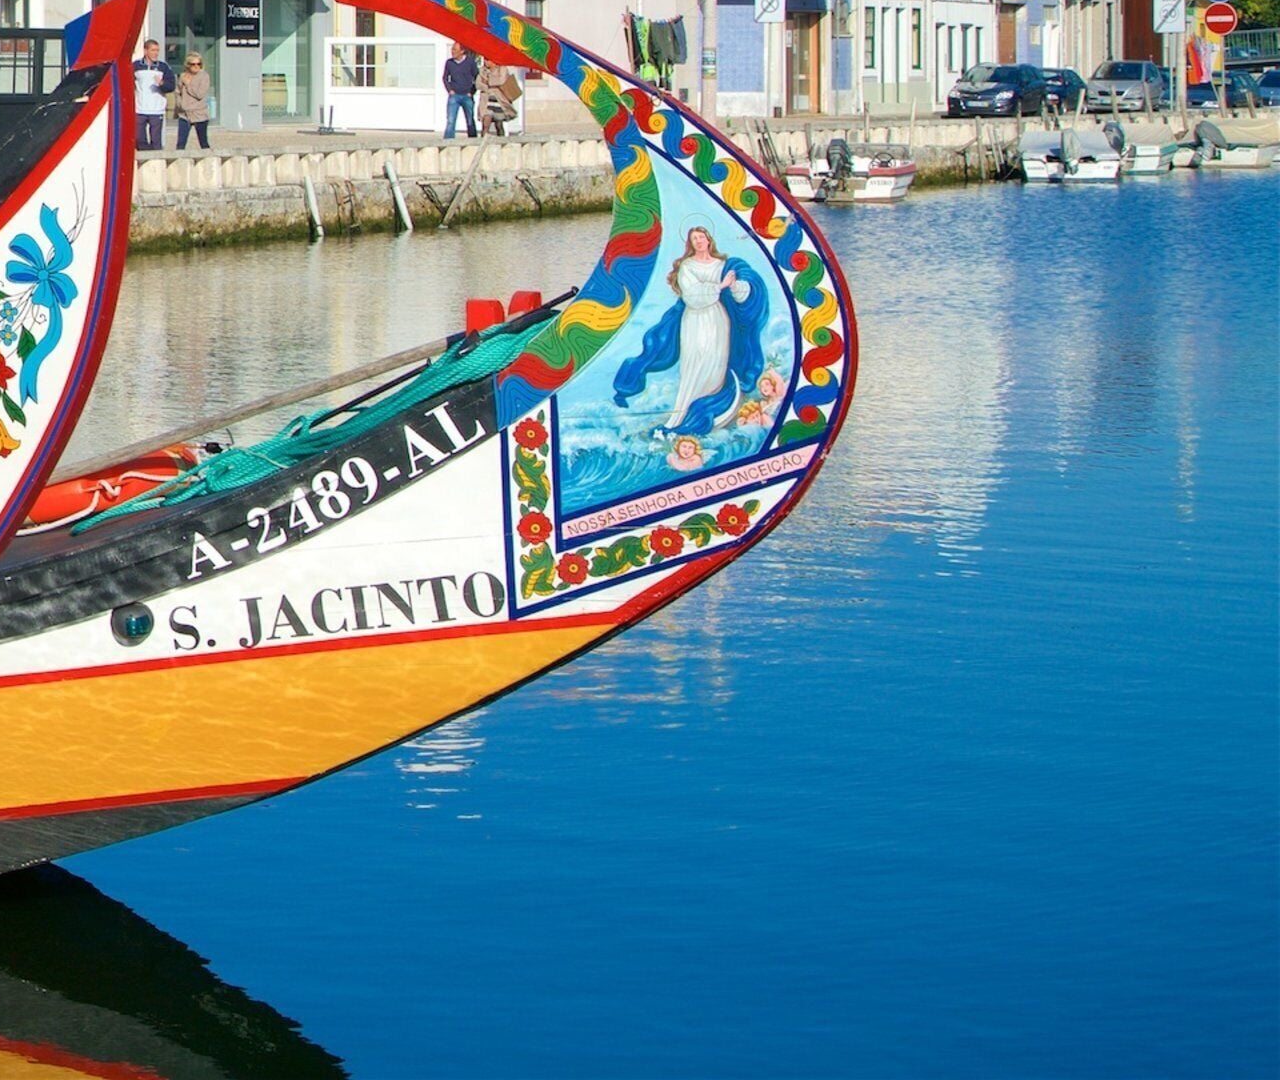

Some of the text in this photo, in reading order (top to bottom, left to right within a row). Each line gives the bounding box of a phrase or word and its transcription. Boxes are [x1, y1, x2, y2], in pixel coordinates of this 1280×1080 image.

[186, 401, 486, 580] A-2489-AL
[567, 452, 803, 536] NOSSA SENHORA DA CONCEIÇÃO
[168, 571, 506, 651] S. JACINTO
